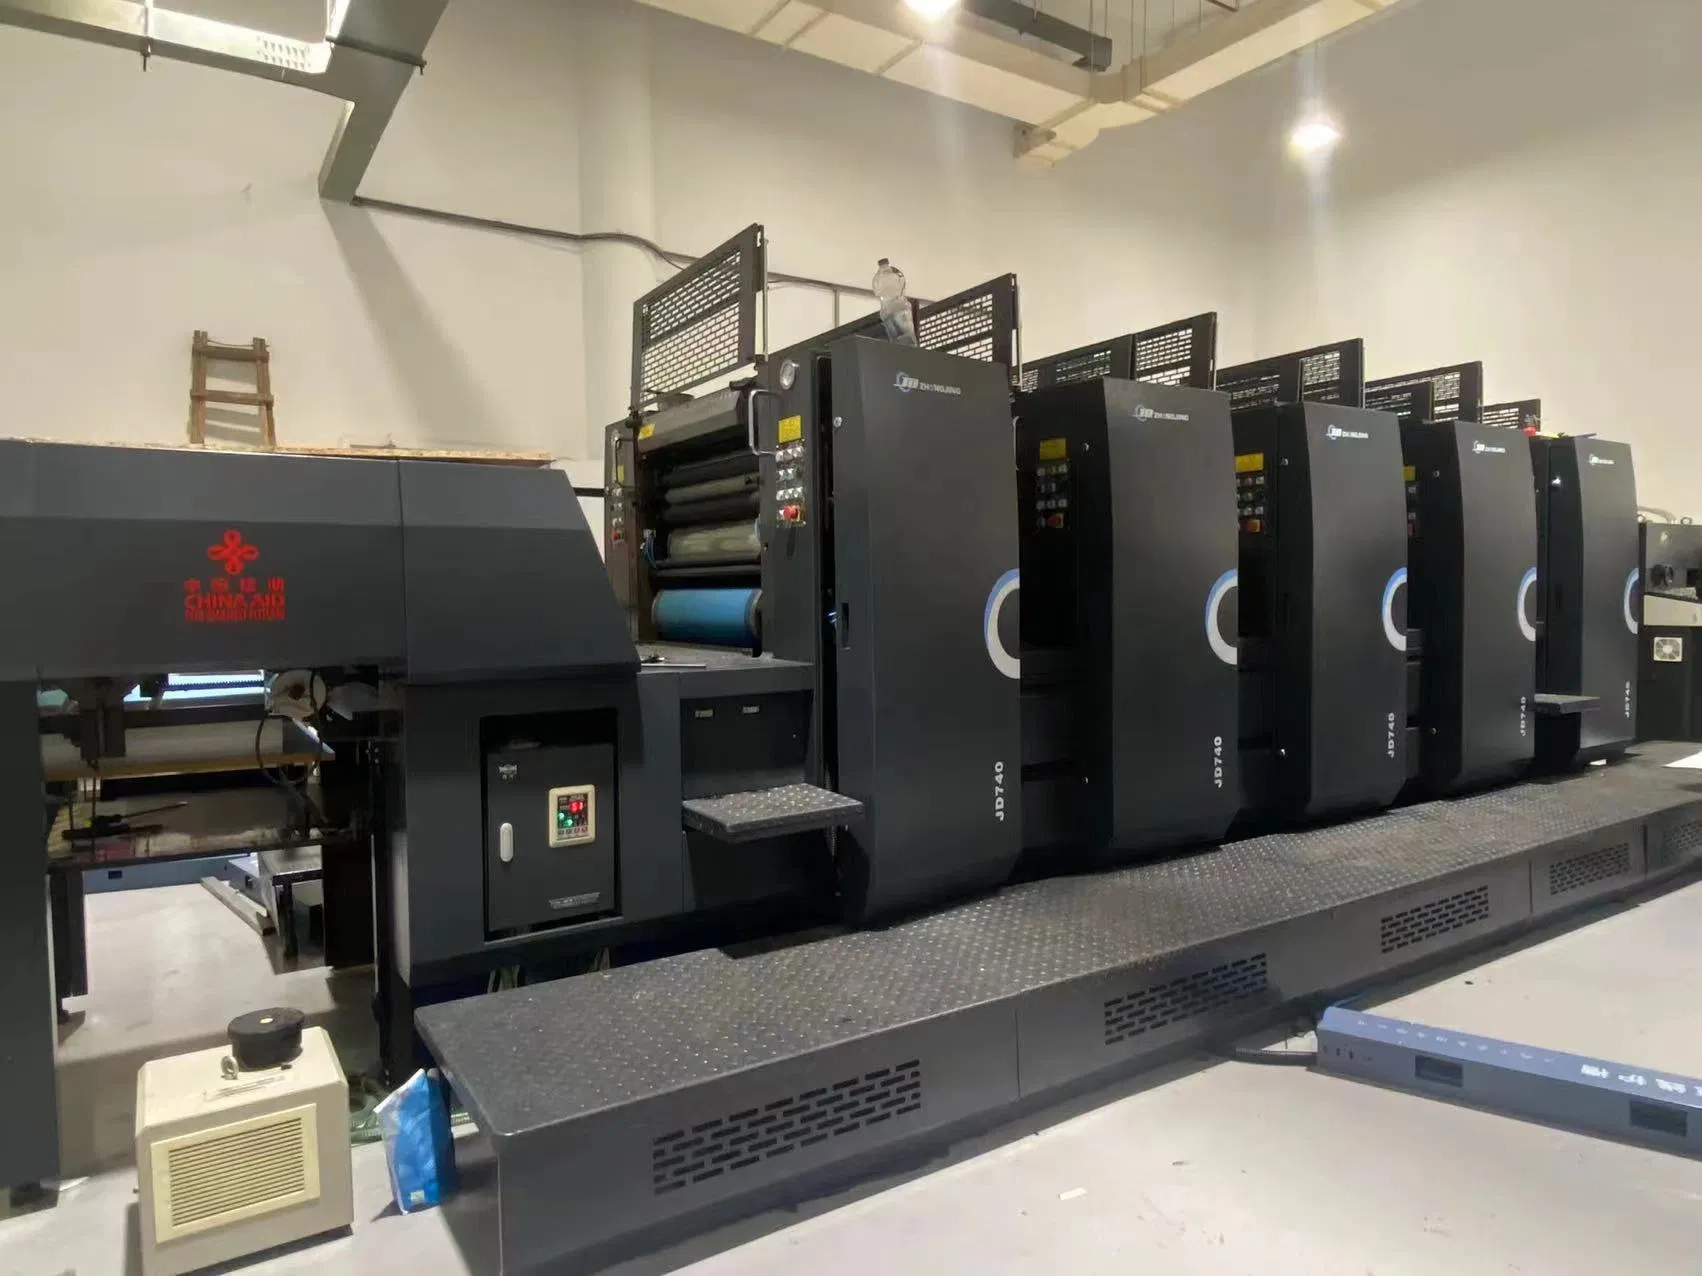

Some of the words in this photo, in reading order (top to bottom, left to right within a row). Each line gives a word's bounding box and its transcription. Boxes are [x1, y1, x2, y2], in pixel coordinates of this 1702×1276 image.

[184, 593, 245, 609] CHINA
[251, 593, 286, 609] AID
[1387, 712, 1396, 759] JD740
[1519, 696, 1527, 737] JD740
[1213, 735, 1223, 789] JD740
[993, 761, 1005, 822] JD740
